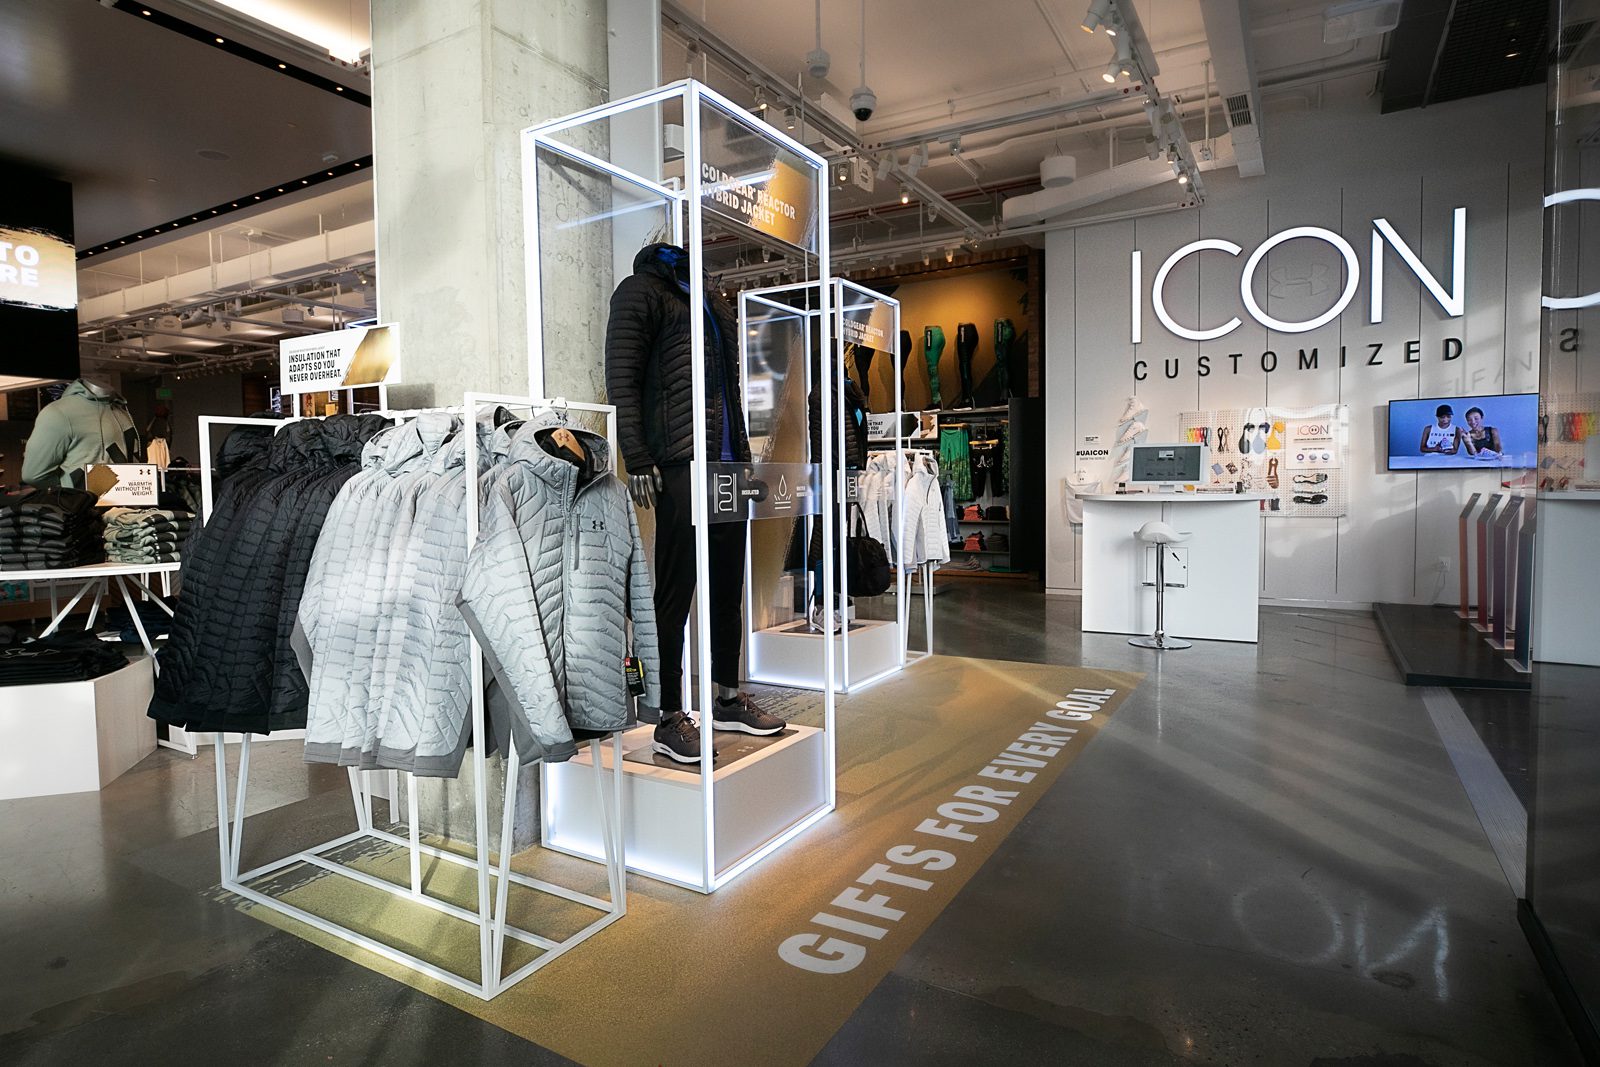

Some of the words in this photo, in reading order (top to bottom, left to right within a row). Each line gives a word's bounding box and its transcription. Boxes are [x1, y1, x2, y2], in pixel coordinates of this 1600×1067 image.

[741, 199, 775, 226] JACKET
[757, 189, 795, 220] REACTOR
[0, 241, 40, 267] TO
[1131, 207, 1466, 344] ICON
[289, 351, 325, 363] INSULATION
[326, 349, 341, 359] THAT
[289, 362, 313, 373] ADAPTS
[313, 361, 322, 371] SO
[323, 360, 335, 369] YOU
[1133, 337, 1464, 381] CUSTOMIZED
[289, 373, 309, 383] NEVER
[310, 369, 342, 381] OVERHEAT.
[1297, 424, 1329, 436] ICON
[778, 844, 957, 974] GIFTS
[913, 785, 1021, 843] FOR
[976, 721, 1080, 784] EVERY
[1045, 687, 1117, 722] GOAL
